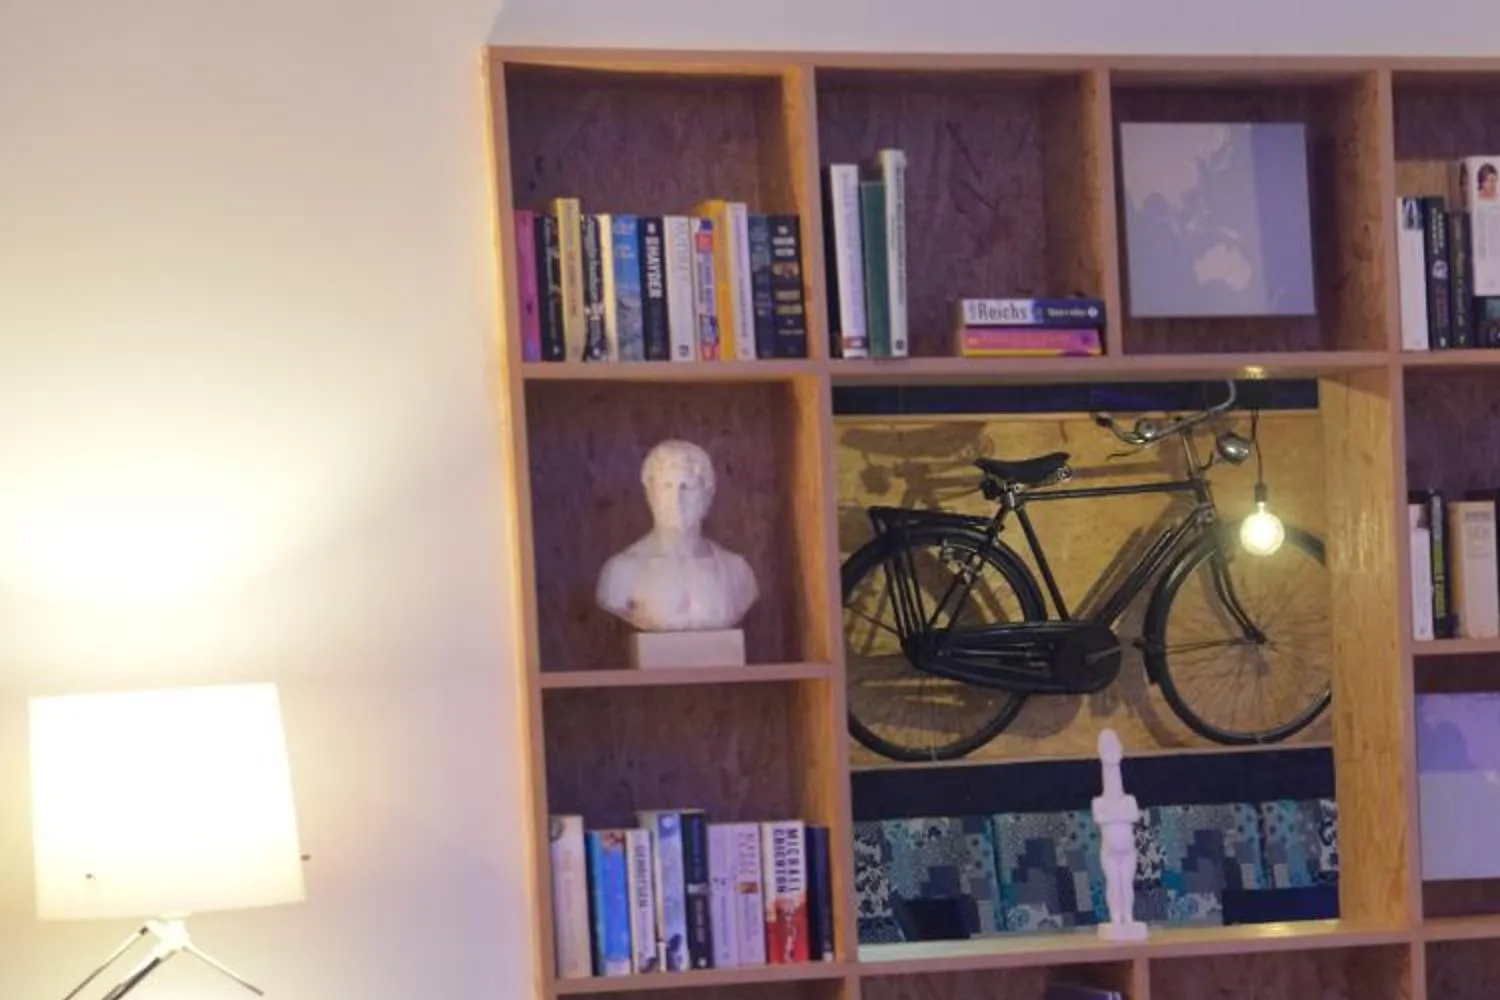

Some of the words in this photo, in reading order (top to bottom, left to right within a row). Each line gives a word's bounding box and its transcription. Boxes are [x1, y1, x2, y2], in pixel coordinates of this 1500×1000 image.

[977, 303, 1028, 321] Reichs
[773, 829, 787, 893] CRICHTON
[787, 828, 800, 891] MICHAEL
